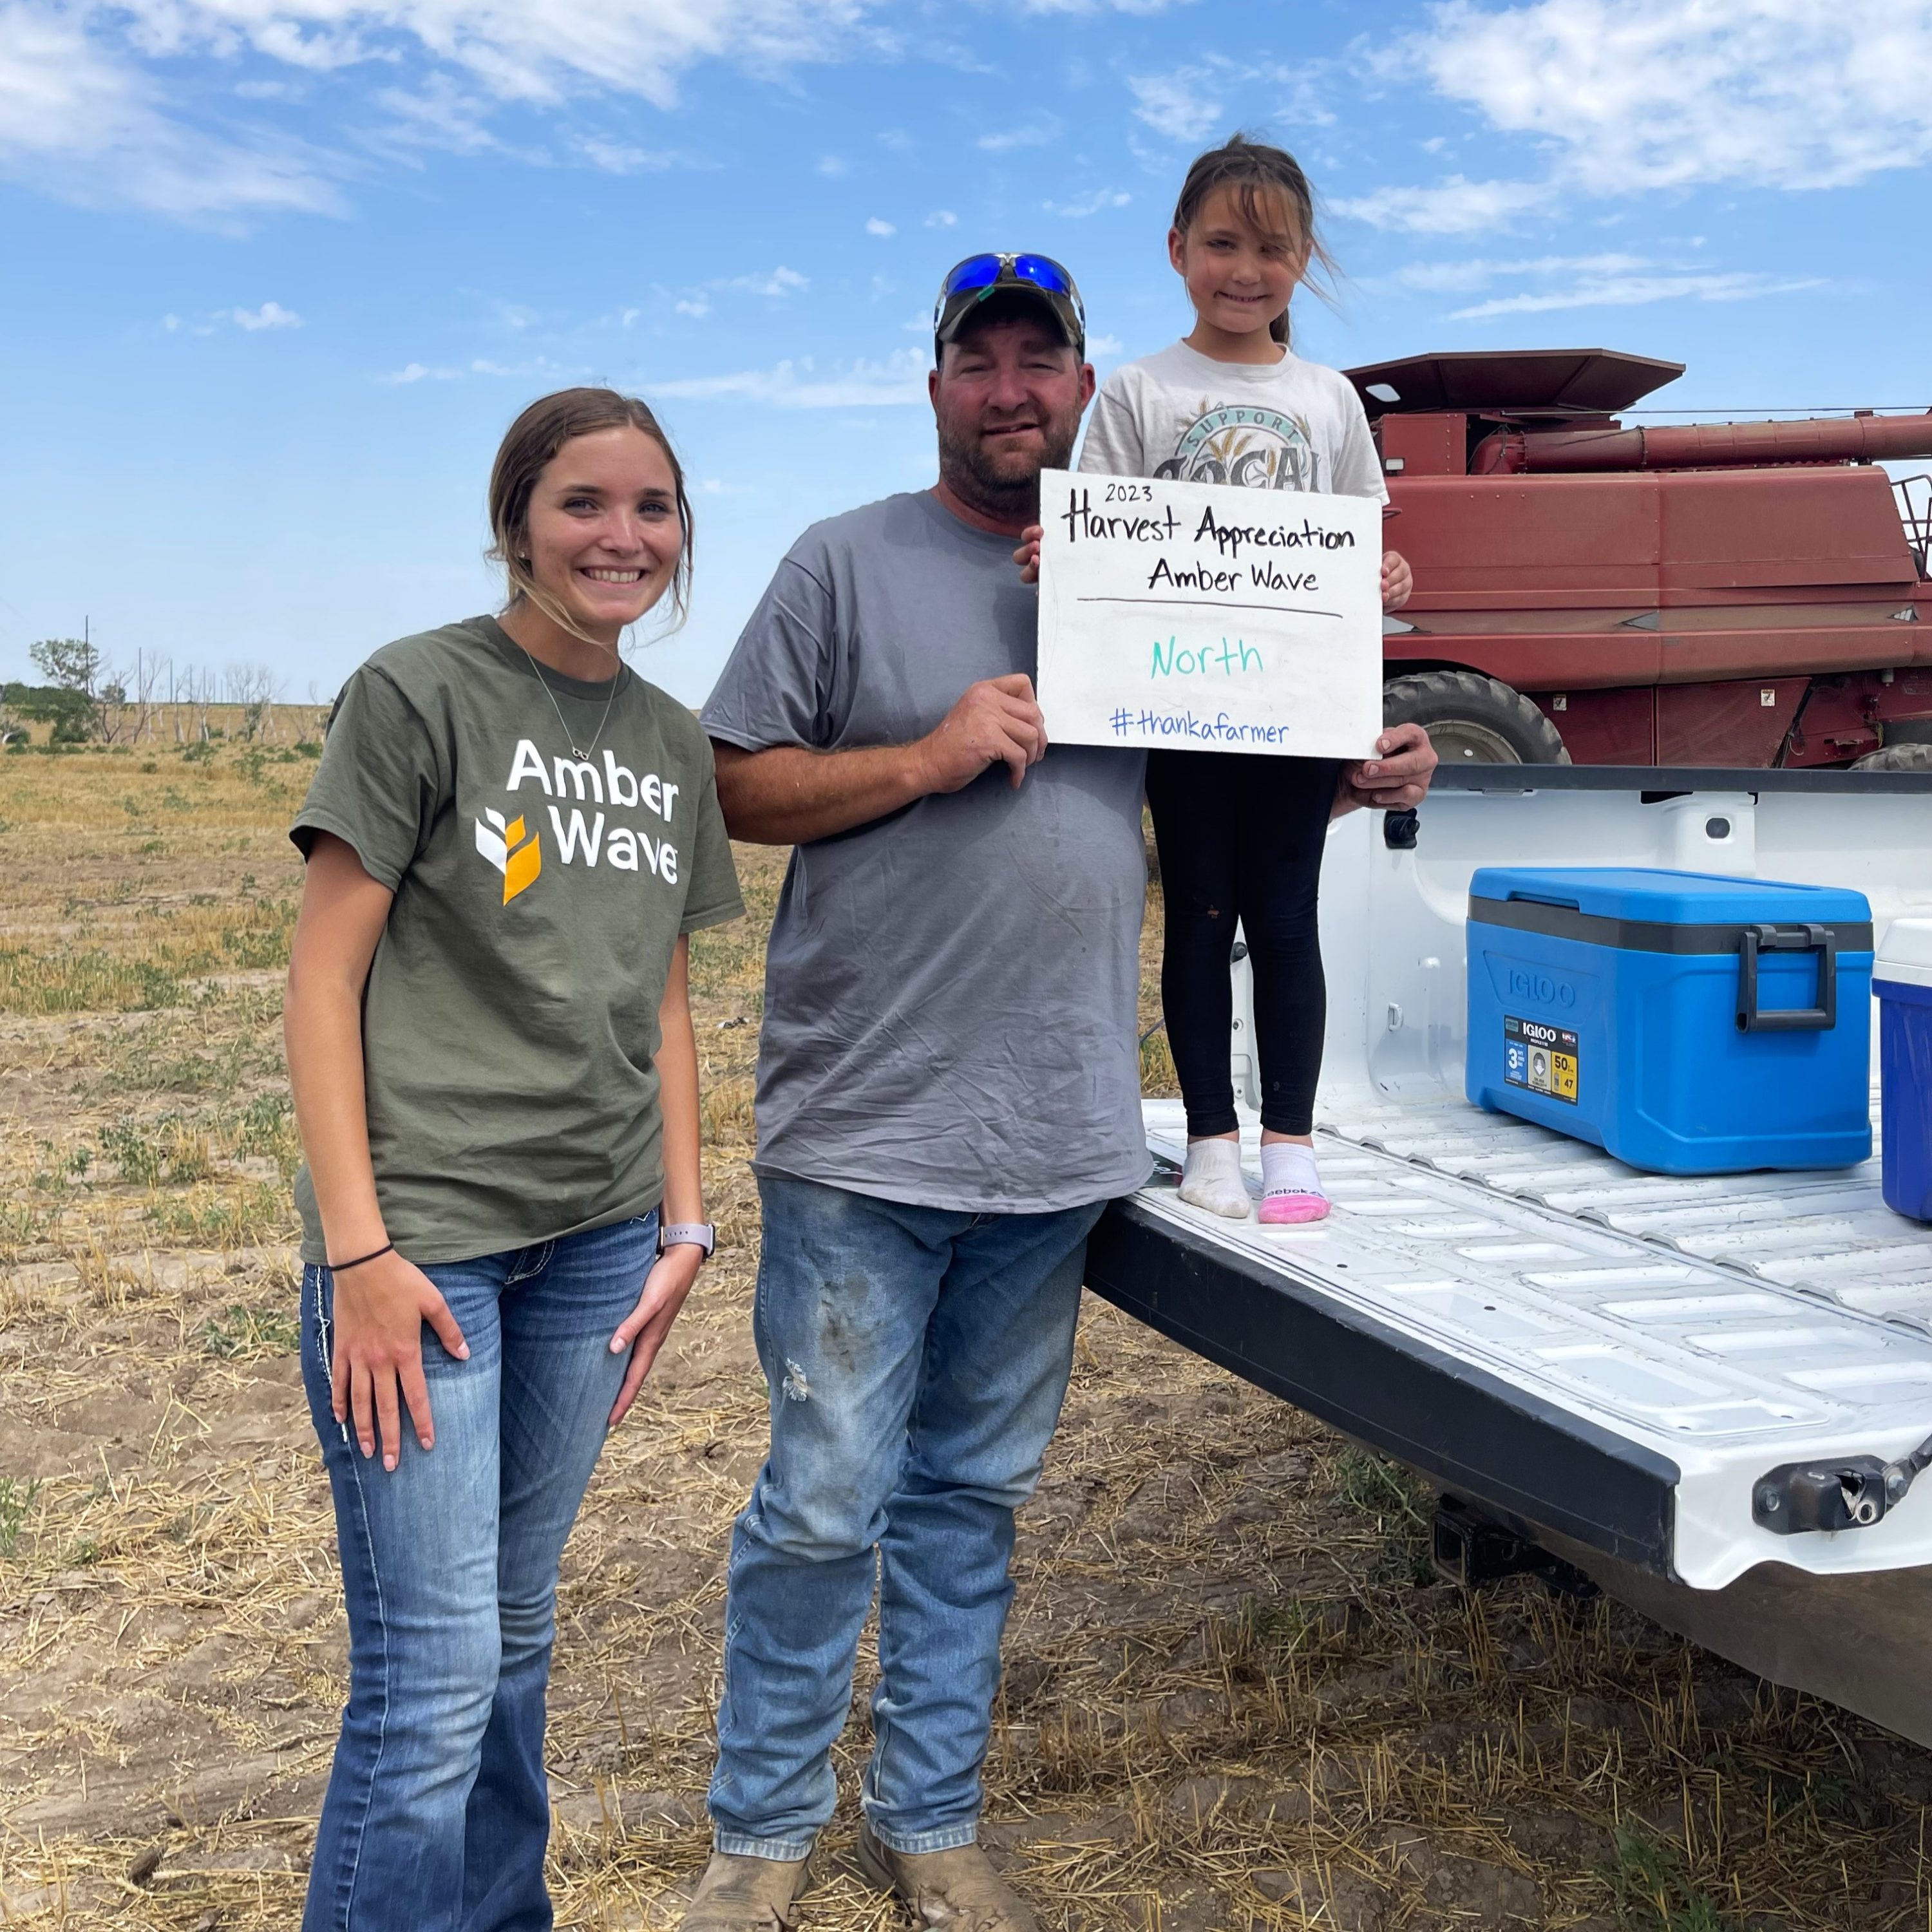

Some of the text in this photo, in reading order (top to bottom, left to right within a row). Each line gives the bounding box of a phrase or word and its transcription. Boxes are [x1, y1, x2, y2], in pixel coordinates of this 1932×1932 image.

[1187, 410, 1299, 448] SUPPORT
[1104, 483, 1153, 502] 2023
[1061, 488, 1355, 559] Harvest Appreciation
[1147, 558, 1320, 591] Amber Wave
[1151, 636, 1264, 679] North
[1110, 707, 1289, 744] #thankafarmer
[506, 739, 679, 823] Amber
[547, 805, 679, 885] Wave
[1508, 969, 1576, 1009] IGLOO
[1522, 1022, 1557, 1043] IGLOO
[1508, 1048, 1518, 1069] 3
[1555, 1055, 1567, 1071] 50
[1564, 1079, 1573, 1089] 47
